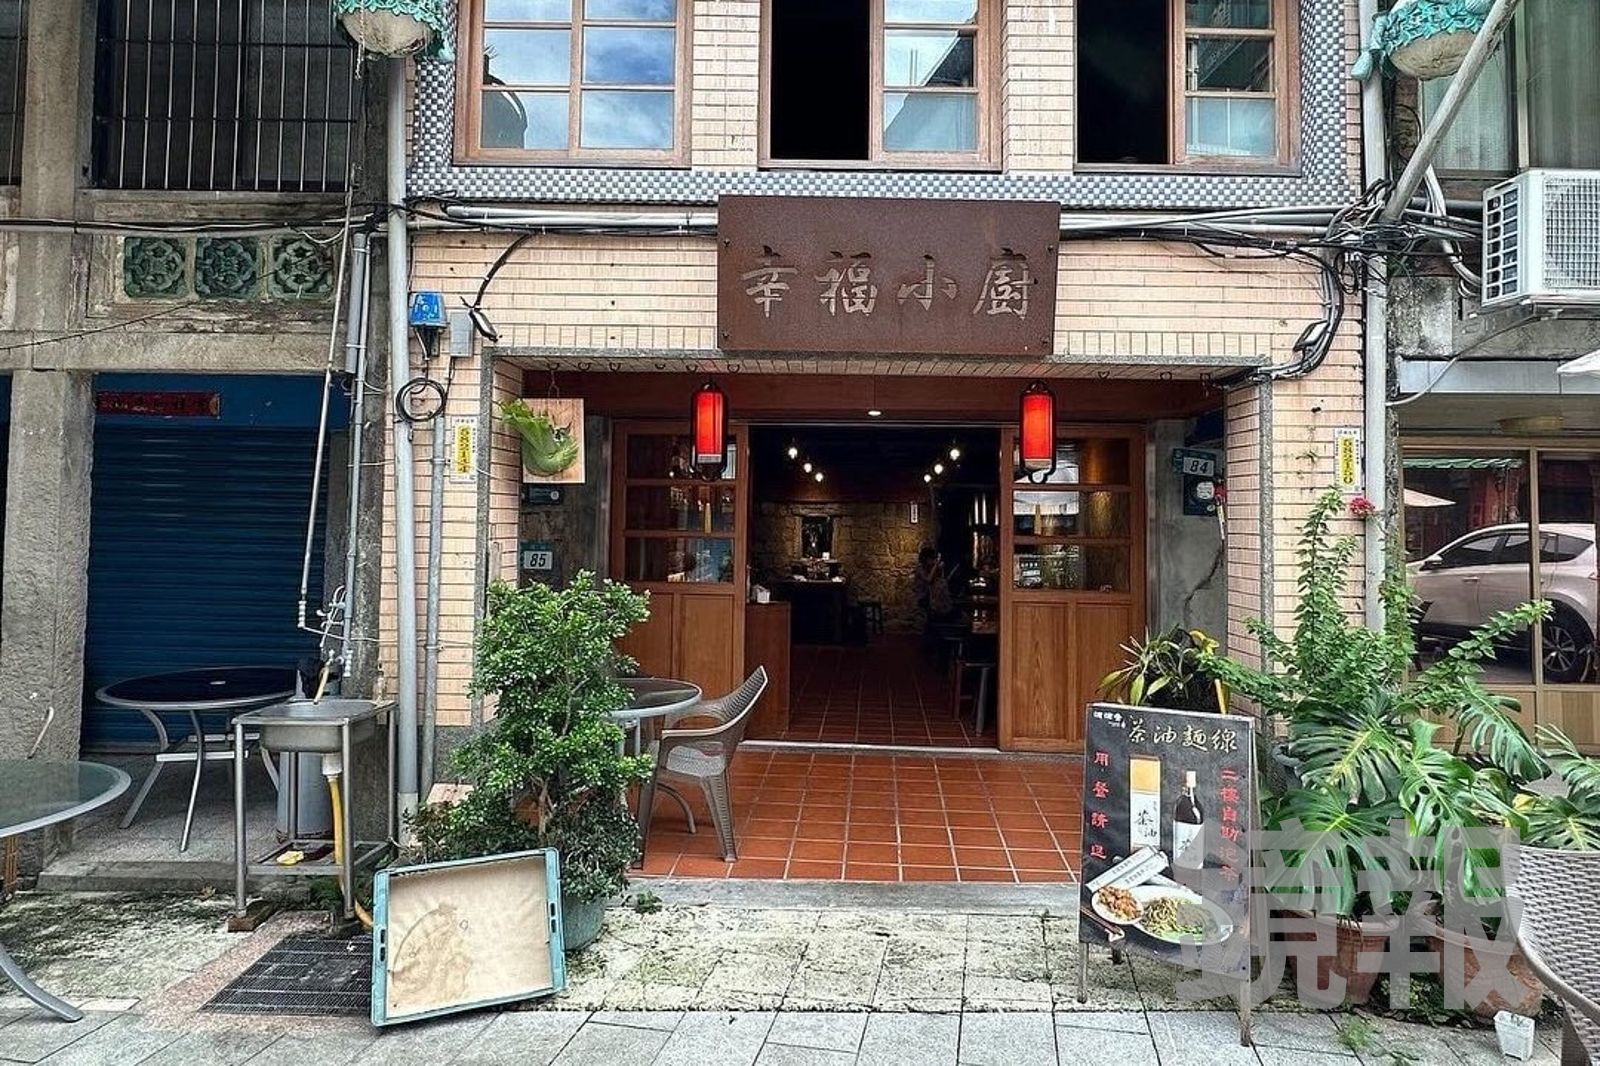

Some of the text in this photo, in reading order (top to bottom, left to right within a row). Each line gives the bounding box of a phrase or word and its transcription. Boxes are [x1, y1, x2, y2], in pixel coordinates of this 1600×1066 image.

[742, 246, 1037, 320] 幸福小廚
[1189, 460, 1209, 474] 84
[529, 553, 547, 568] 85
[1129, 714, 1238, 753] 茶油麵線
